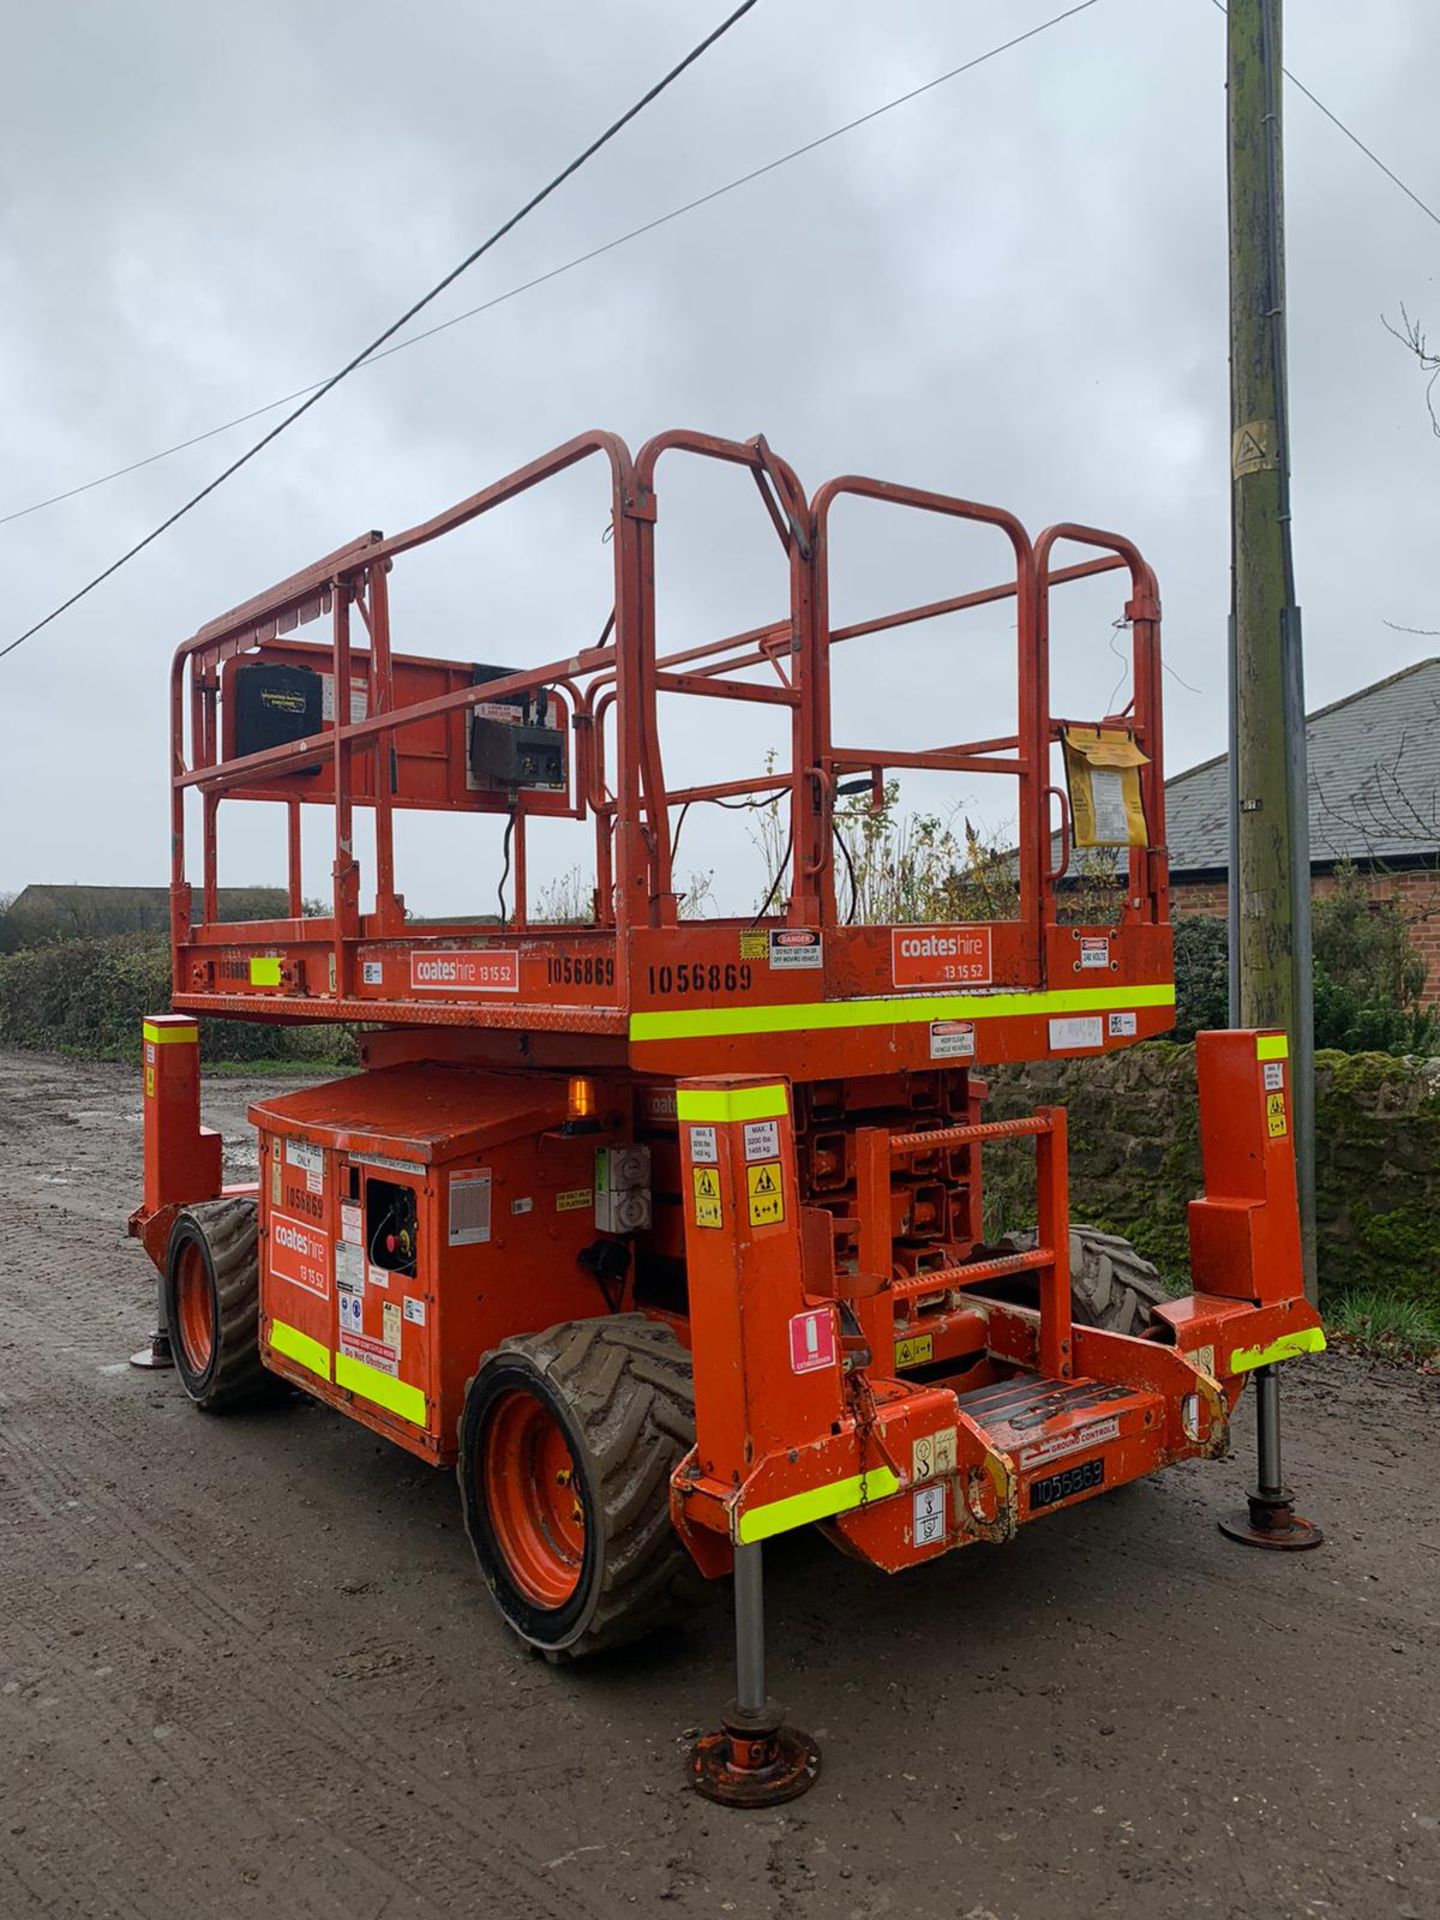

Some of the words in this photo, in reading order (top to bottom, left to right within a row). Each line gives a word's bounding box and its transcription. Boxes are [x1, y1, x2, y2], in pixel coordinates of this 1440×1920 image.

[782, 935, 811, 944] DANGER
[901, 935, 983, 957] coateshire
[1093, 952, 1106, 961] VOLTS
[417, 957, 476, 981] coateshire
[480, 966, 489, 980] 13
[491, 966, 500, 981] 15
[501, 966, 512, 981] 52
[548, 957, 615, 987] 1056869
[648, 963, 752, 995] 1056869
[945, 965, 955, 979] 13
[958, 965, 969, 979] 15
[971, 964, 983, 978] 52
[297, 1154, 312, 1167] ONLY
[306, 1144, 322, 1158] FUEL
[286, 1186, 324, 1219] 1056869
[276, 1225, 324, 1262] coateshire
[300, 1265, 307, 1281] 13
[308, 1268, 315, 1285] 15
[316, 1272, 324, 1289] 52
[345, 1347, 353, 1357] Do
[354, 1350, 365, 1362] Not
[1051, 1437, 1080, 1453] GROUND
[1081, 1423, 1116, 1443] CONTROLS
[1037, 1461, 1102, 1503] 1056869
